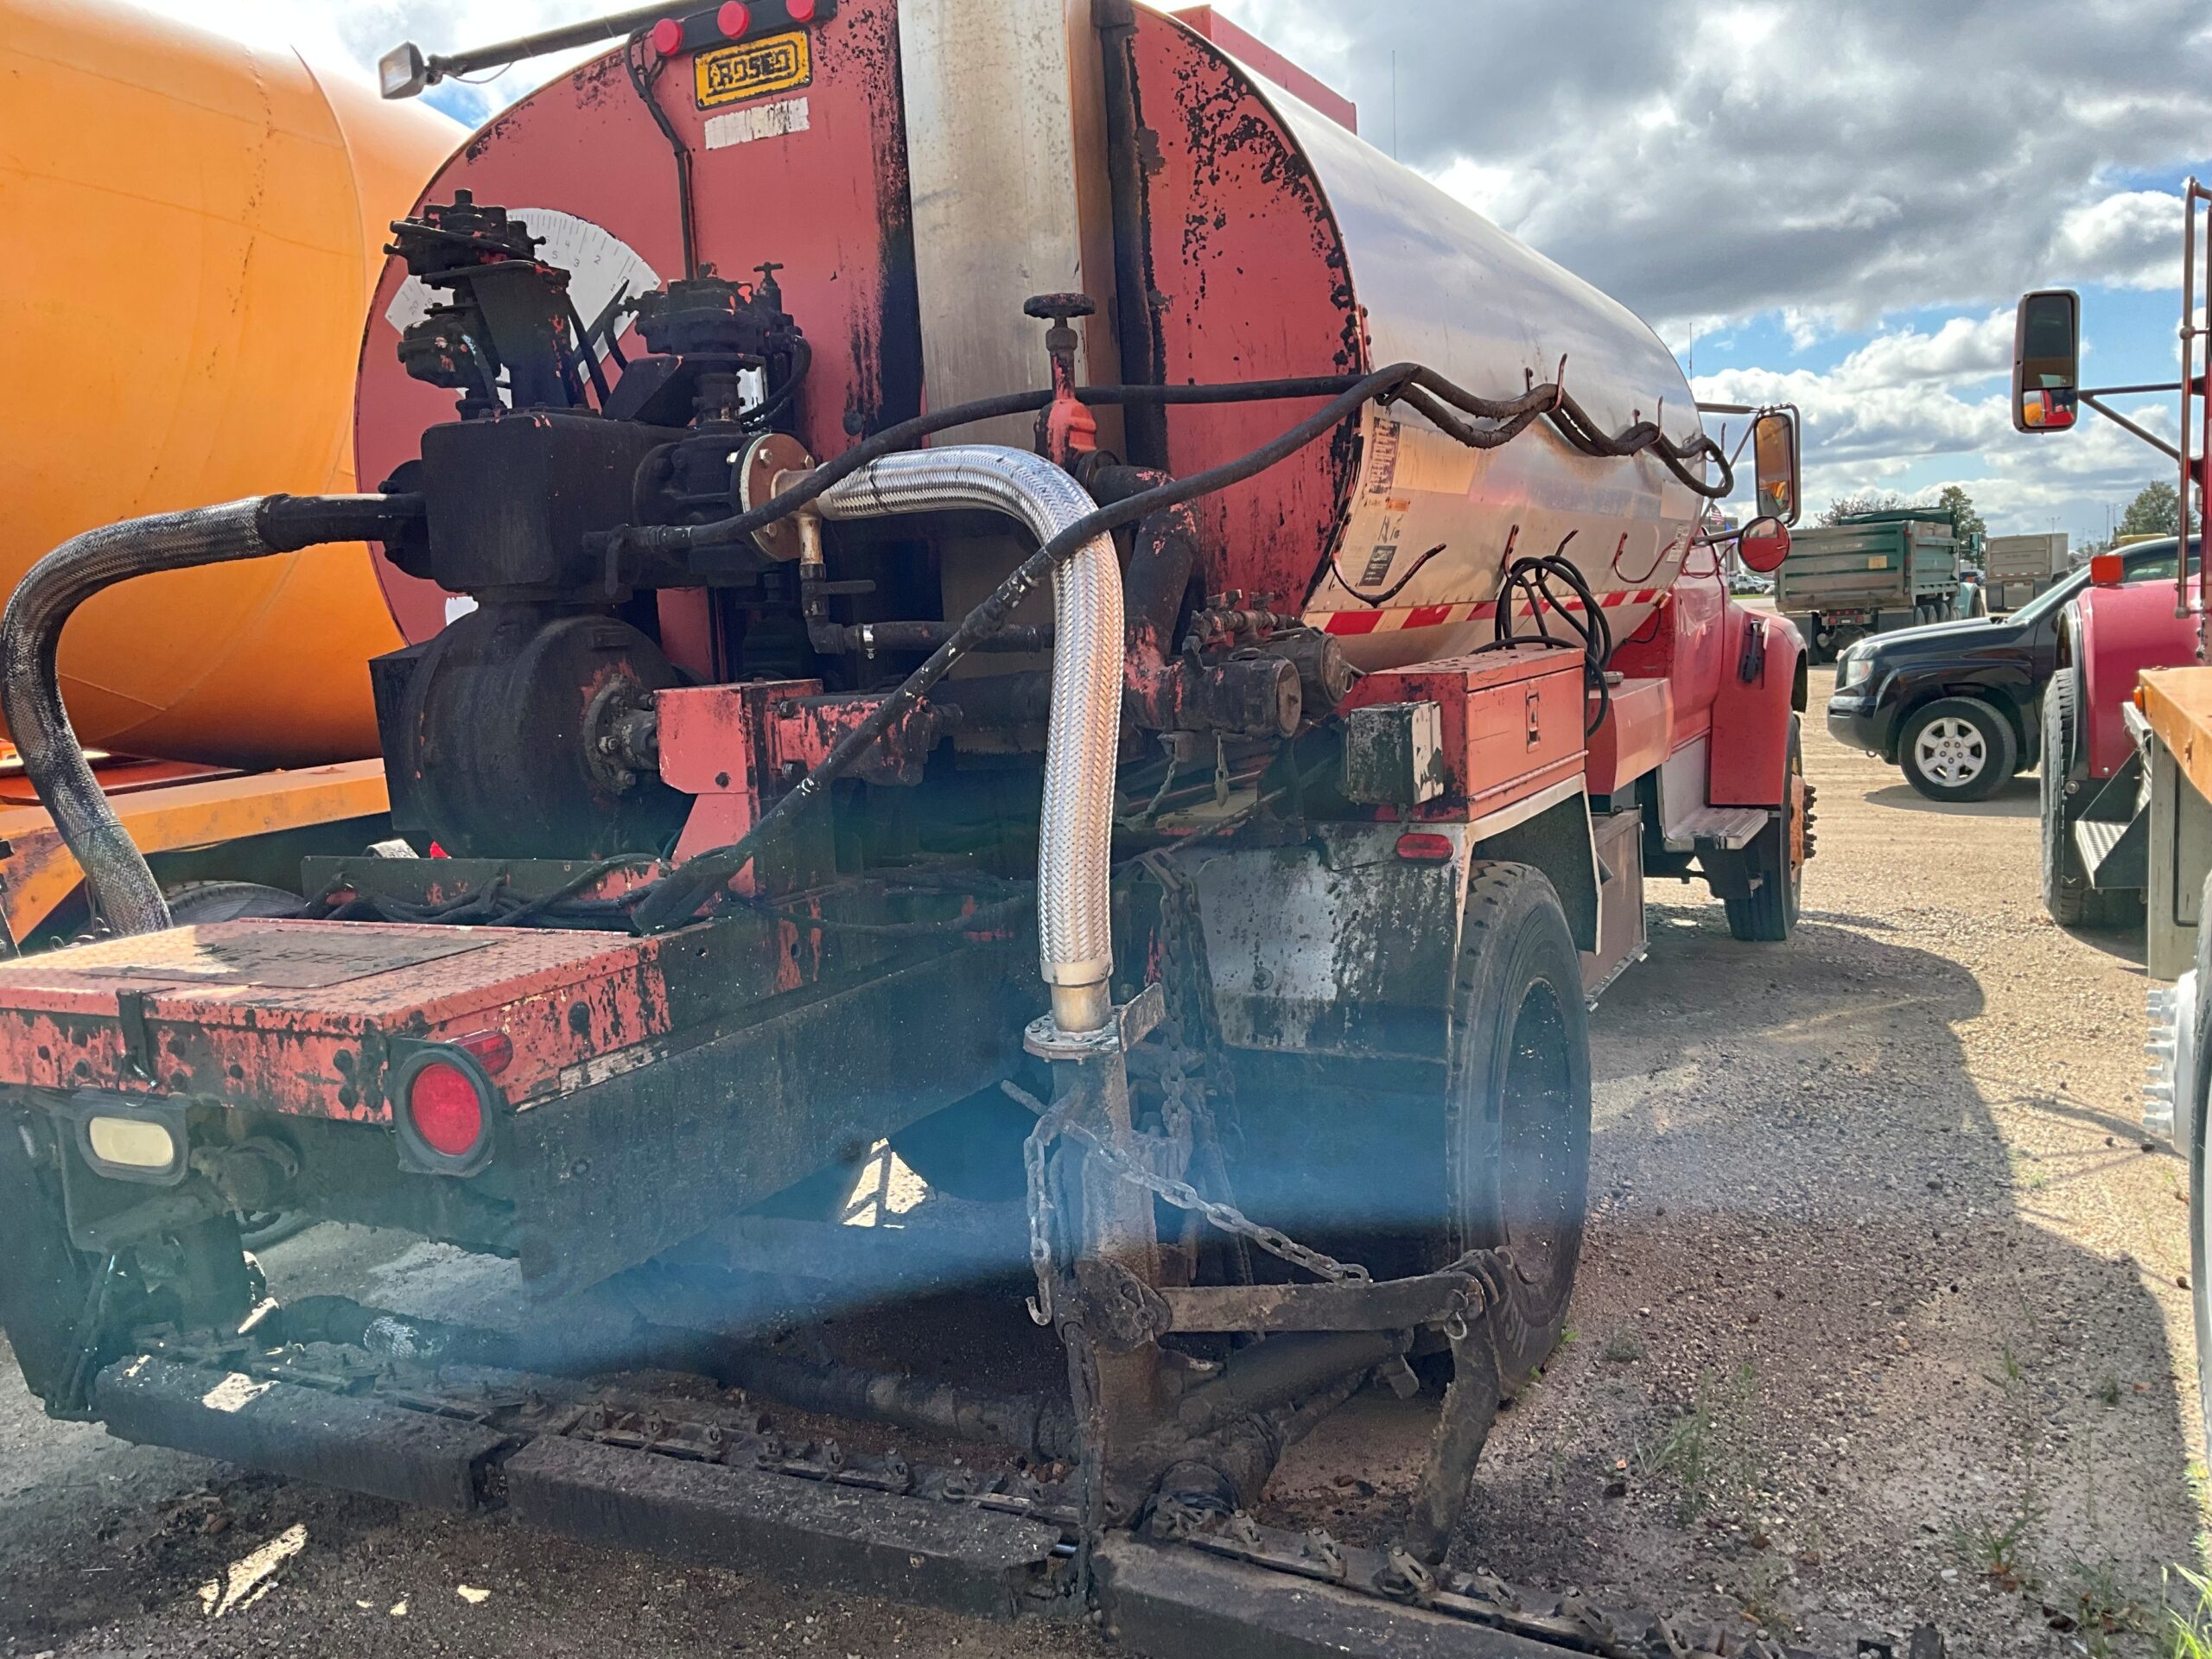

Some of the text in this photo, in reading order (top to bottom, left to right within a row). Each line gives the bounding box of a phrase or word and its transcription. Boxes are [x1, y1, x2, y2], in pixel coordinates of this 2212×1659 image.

[564, 240, 571, 249] 4
[552, 251, 559, 259] 5
[594, 255, 601, 264] 2
[573, 258, 581, 268] 3
[609, 283, 616, 292] 1
[409, 301, 418, 315] 20
